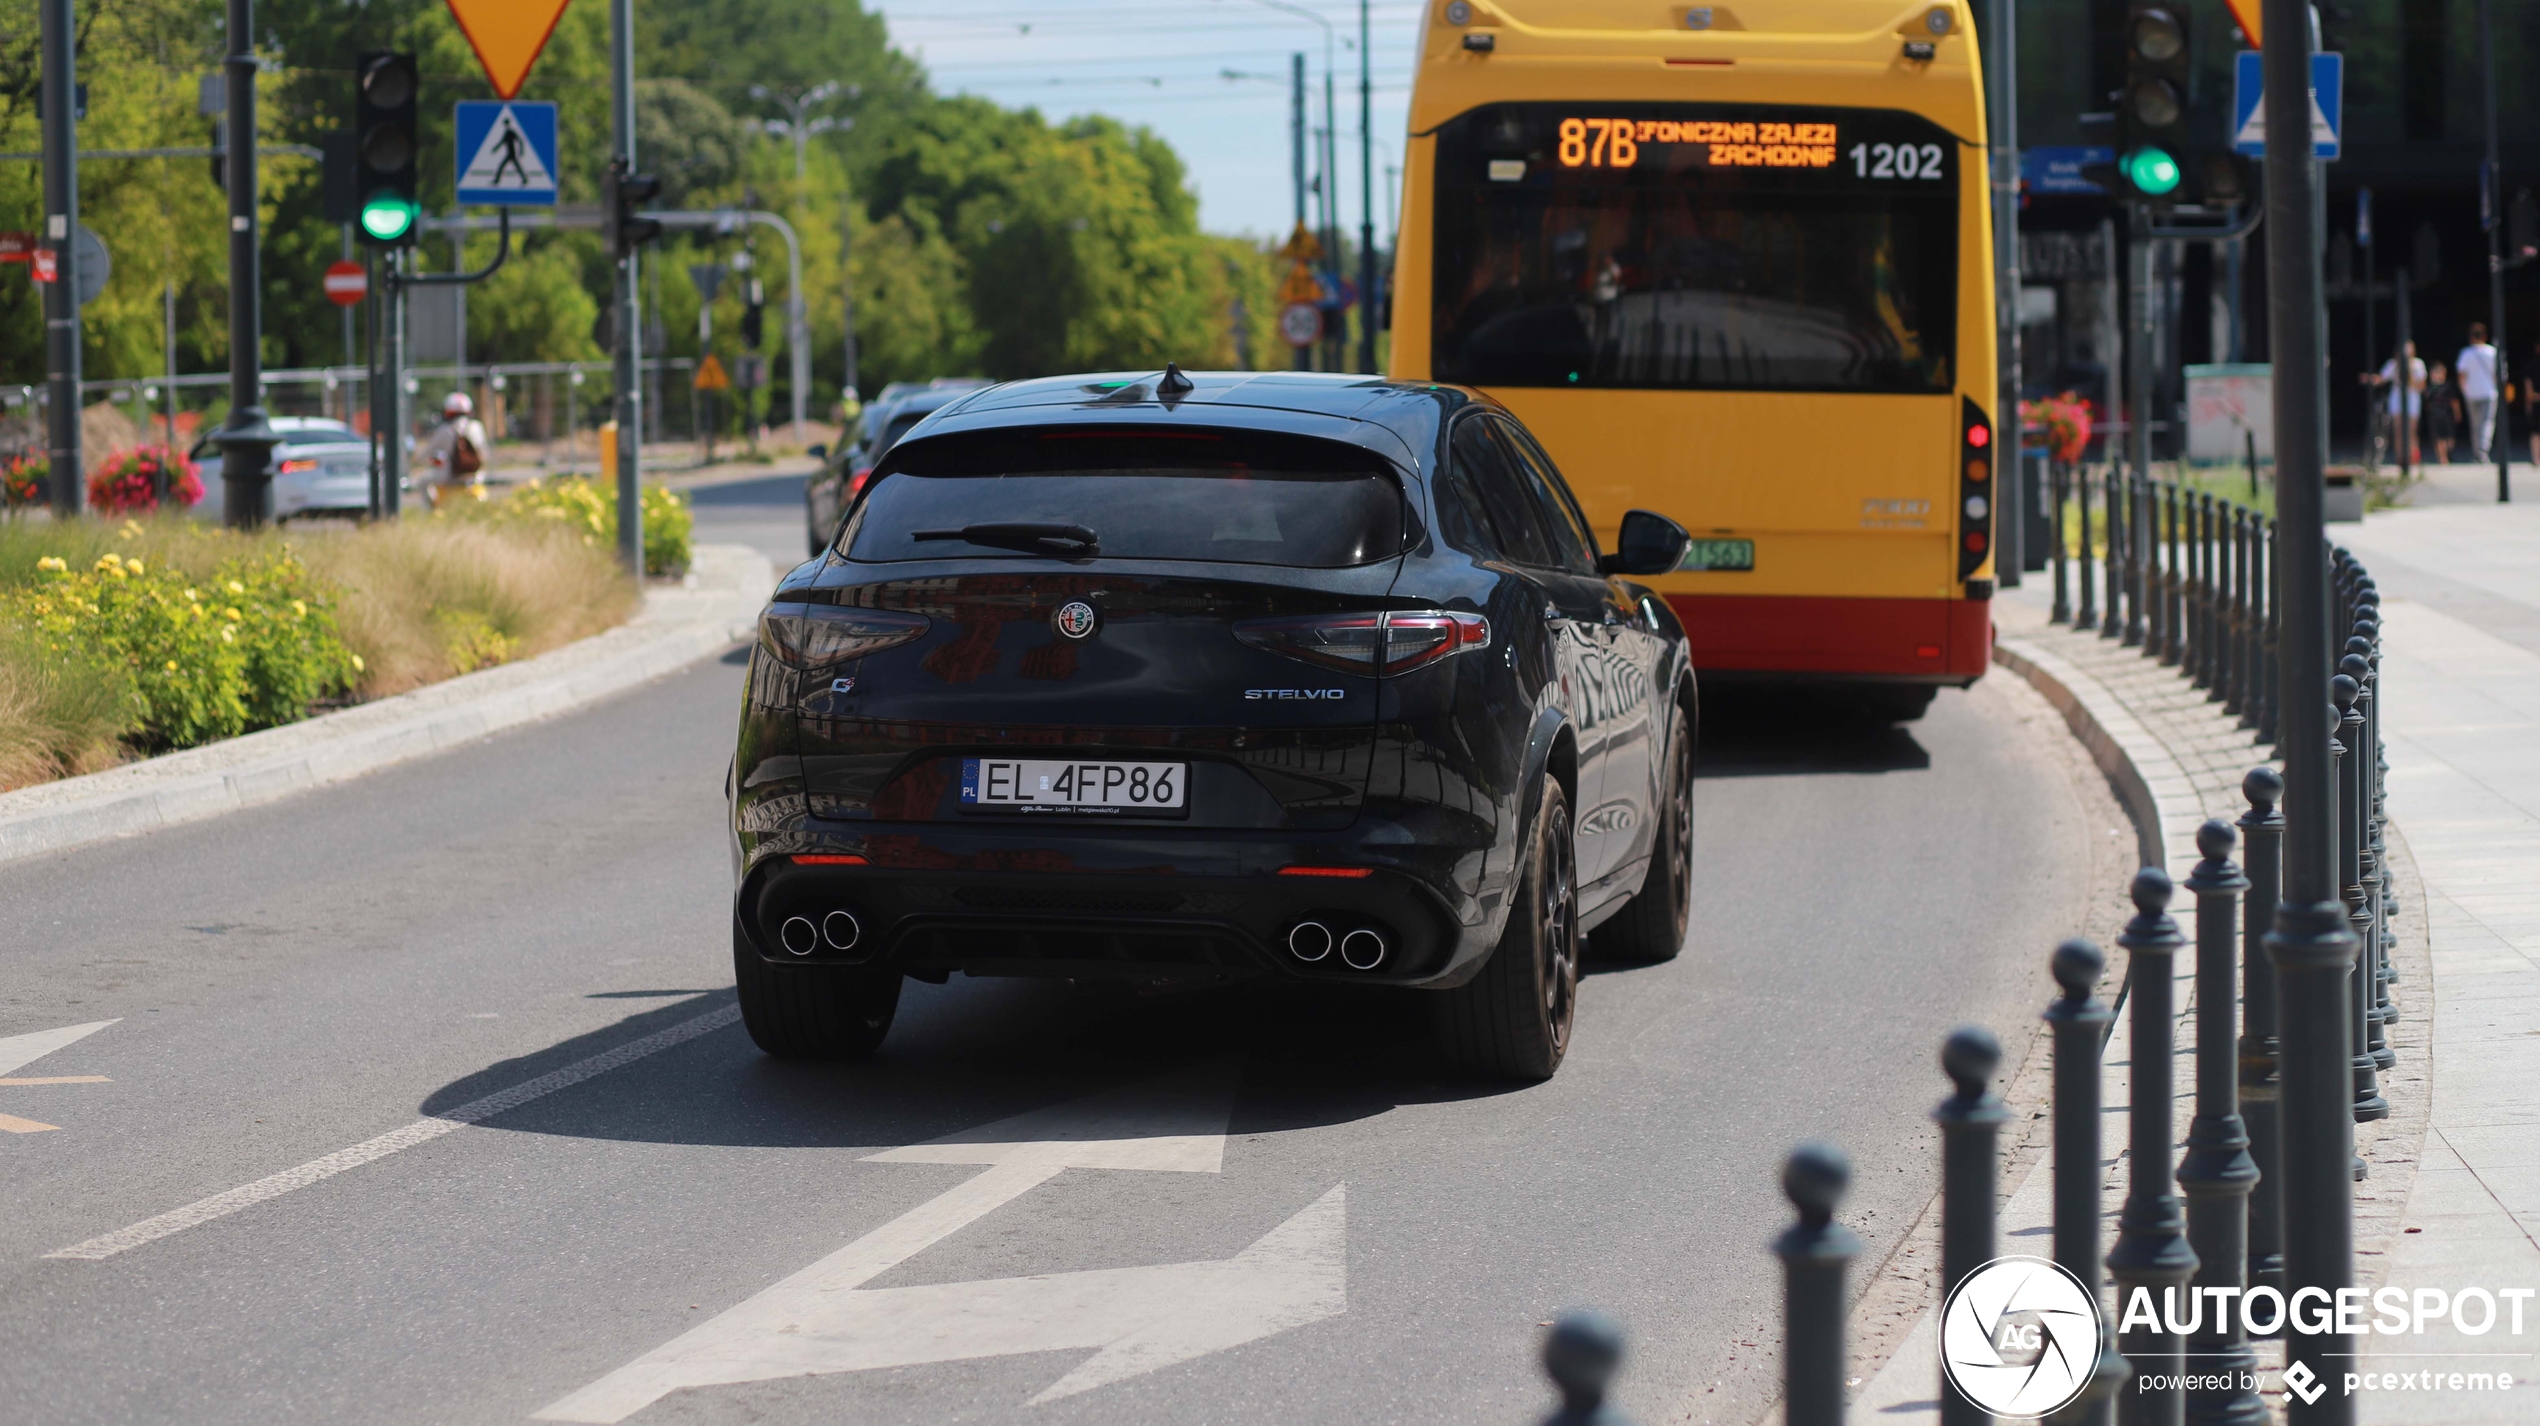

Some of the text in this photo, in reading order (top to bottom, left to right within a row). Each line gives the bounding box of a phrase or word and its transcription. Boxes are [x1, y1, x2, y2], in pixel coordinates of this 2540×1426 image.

[1558, 117, 1638, 167] 87B
[1848, 142, 1944, 179] 1202
[1244, 689, 1345, 700] STELVIO
[962, 787, 977, 798] PL
[986, 763, 1175, 803] EL 4FP86
